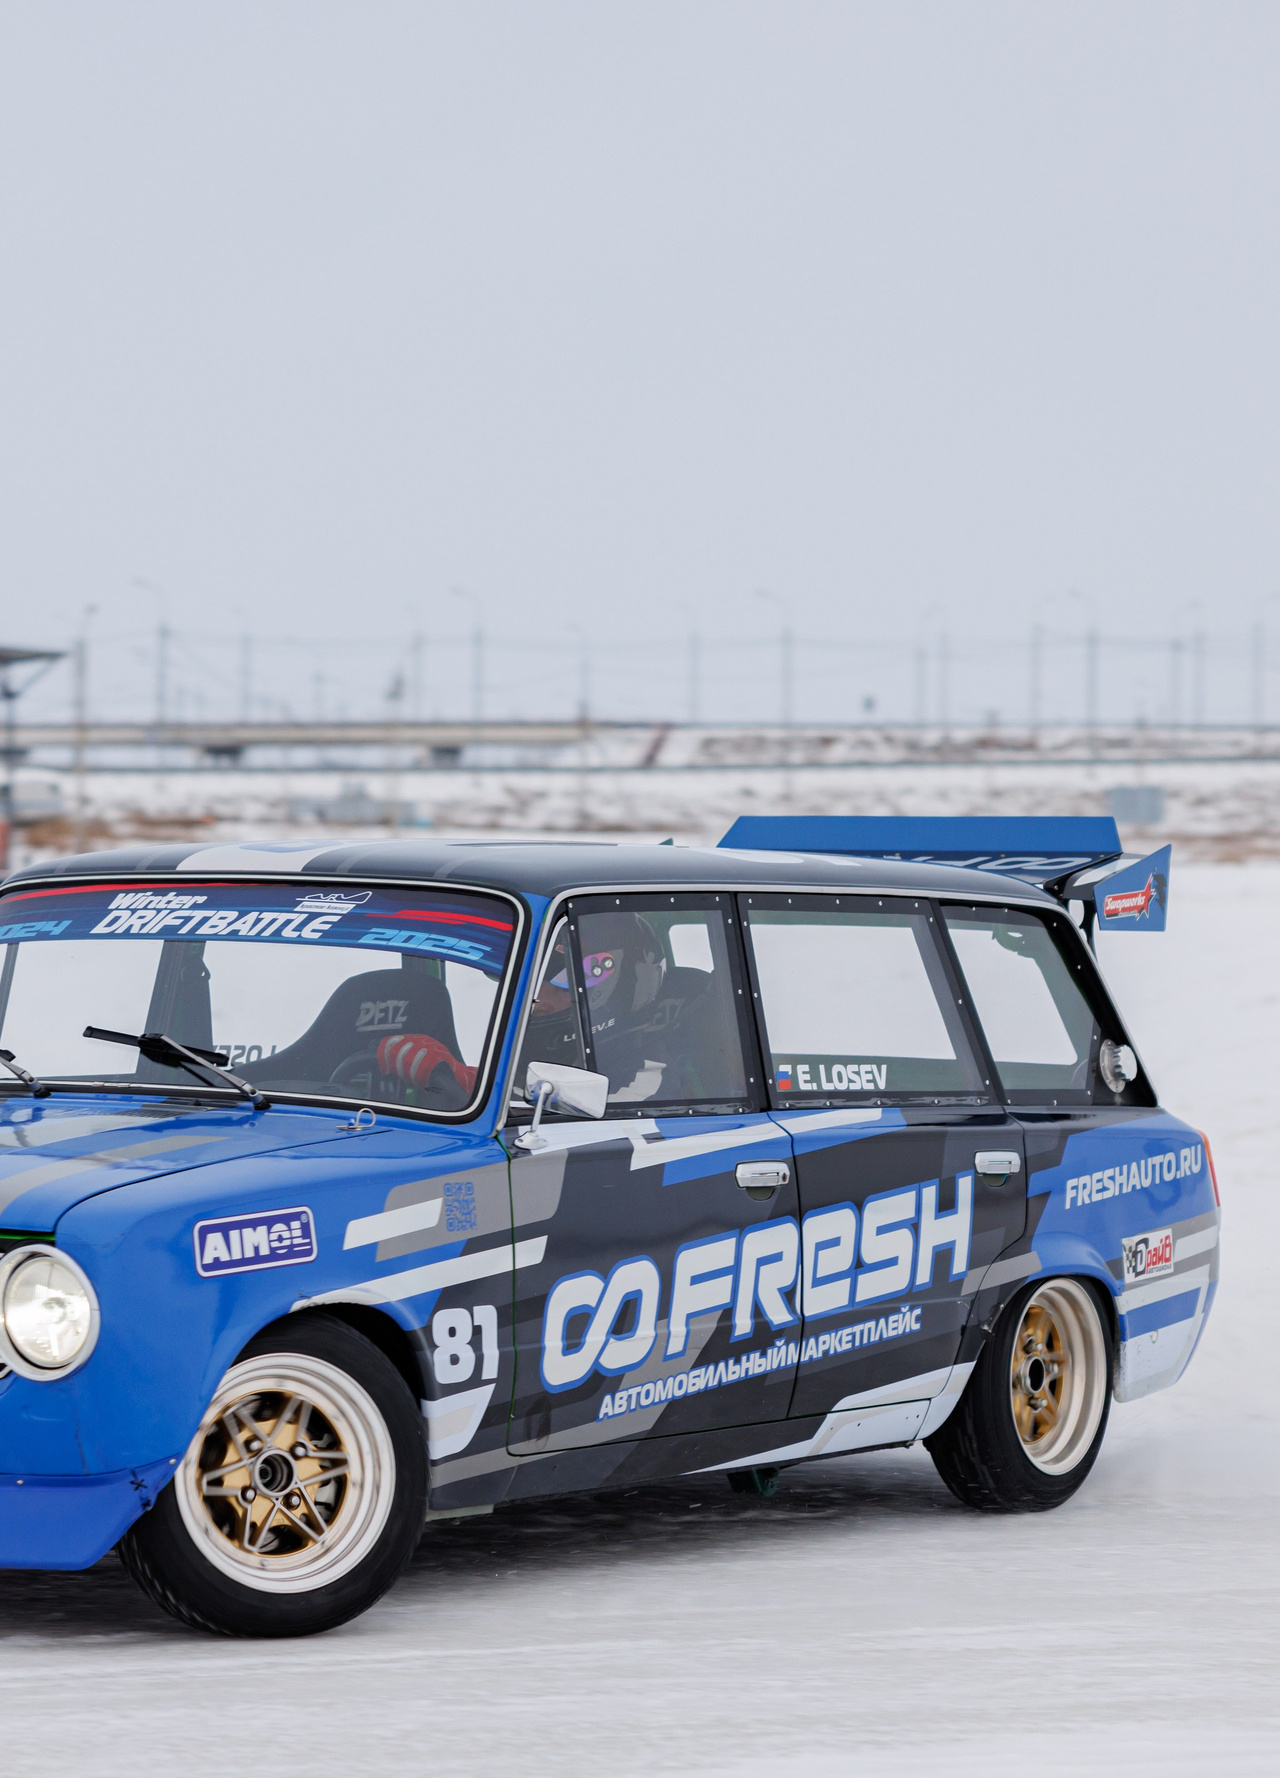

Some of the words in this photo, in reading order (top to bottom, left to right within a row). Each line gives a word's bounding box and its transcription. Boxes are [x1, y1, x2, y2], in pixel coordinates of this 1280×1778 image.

[107, 892, 208, 910] Winter
[89, 909, 342, 939] DRIFTBATTLE
[358, 927, 493, 961] 2025
[796, 1064, 818, 1090] E.
[819, 1064, 887, 1090] LOSEV
[1064, 1143, 1202, 1210] FRESHAUTO.RU
[431, 1304, 500, 1386] 81
